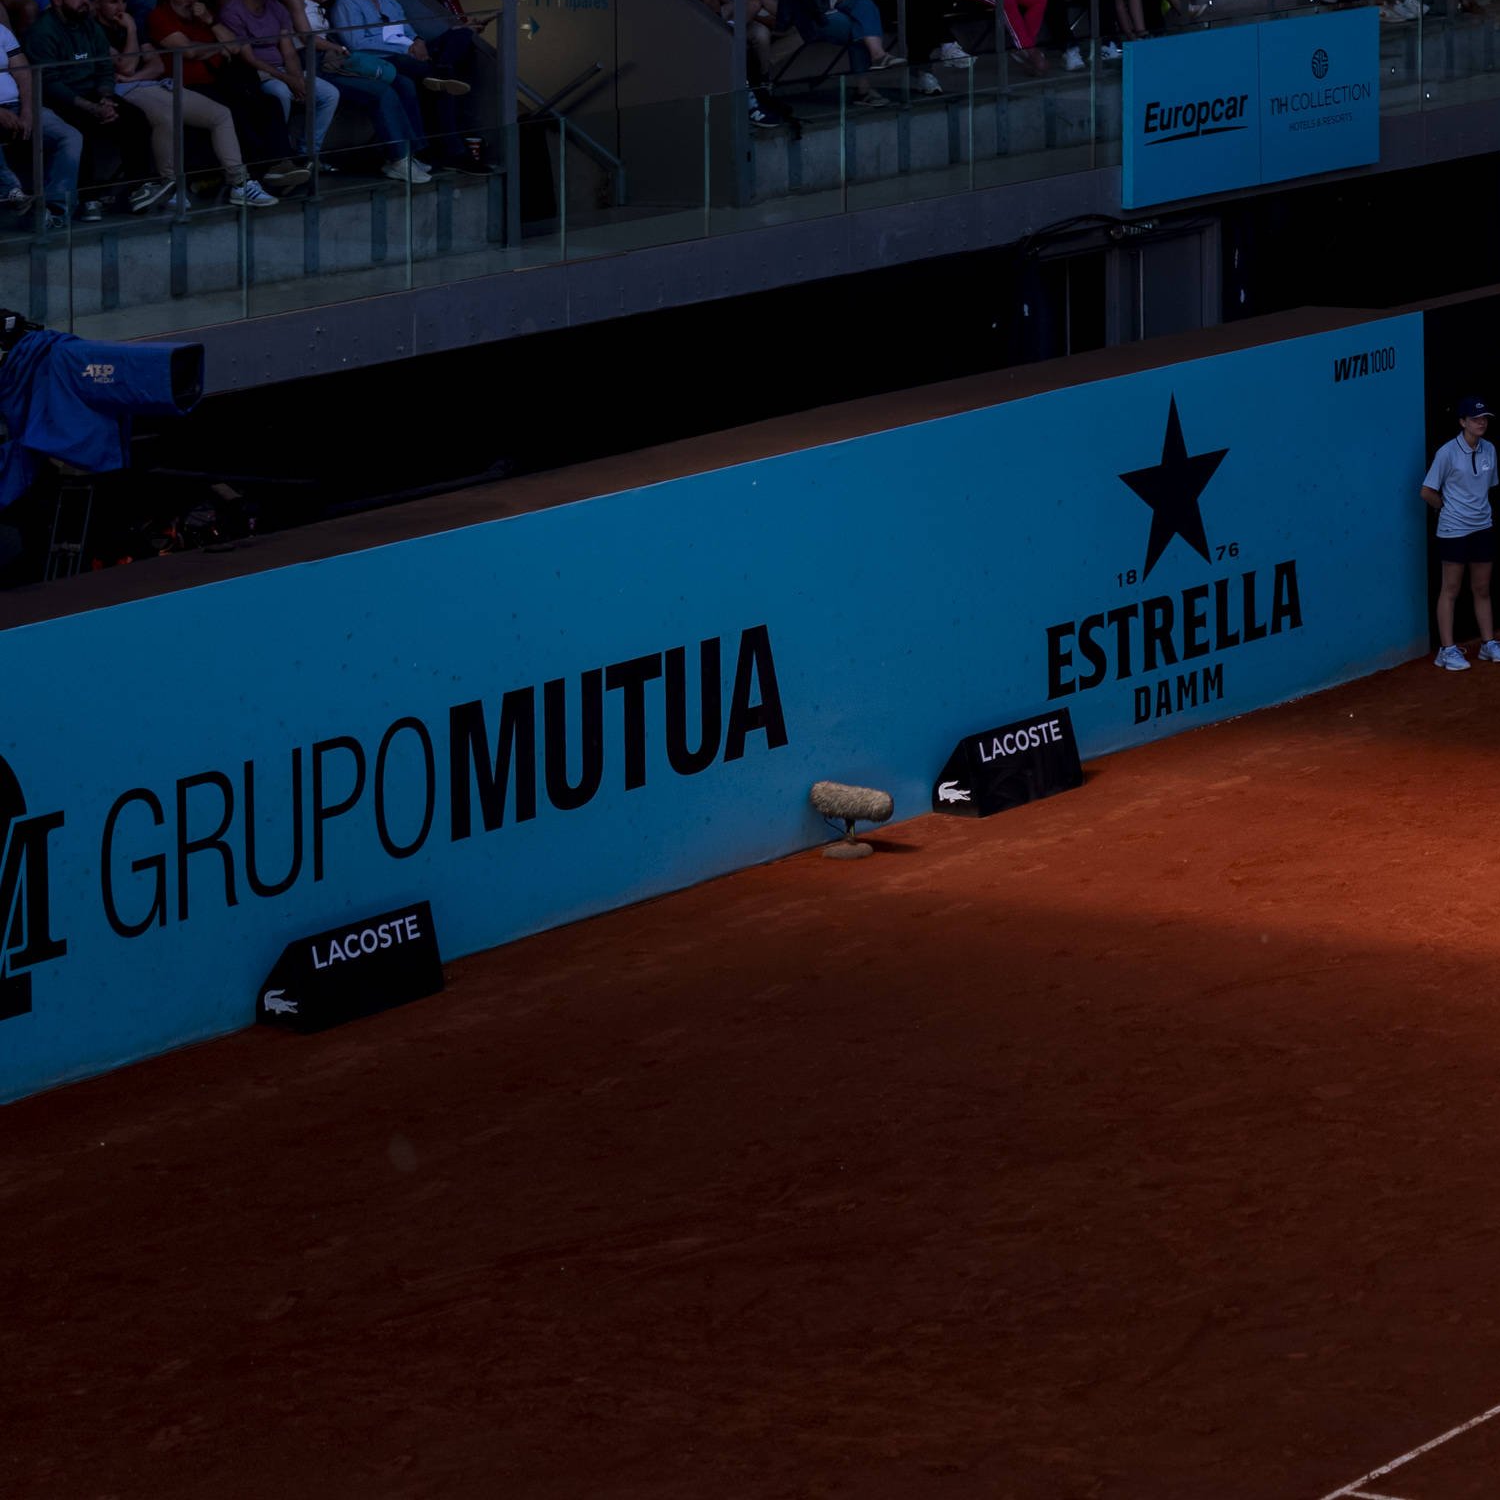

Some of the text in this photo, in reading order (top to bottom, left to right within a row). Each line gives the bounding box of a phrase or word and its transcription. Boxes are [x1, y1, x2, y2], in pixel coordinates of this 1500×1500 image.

[1143, 93, 1249, 136] Europcar
[1290, 83, 1372, 112] COLLECTION
[1117, 541, 1240, 588] 18 76
[1046, 559, 1304, 701] ESTRELLA
[1134, 663, 1224, 725] DAMM
[978, 719, 1064, 764] LACOSTE
[311, 913, 422, 972] LACOSTE
